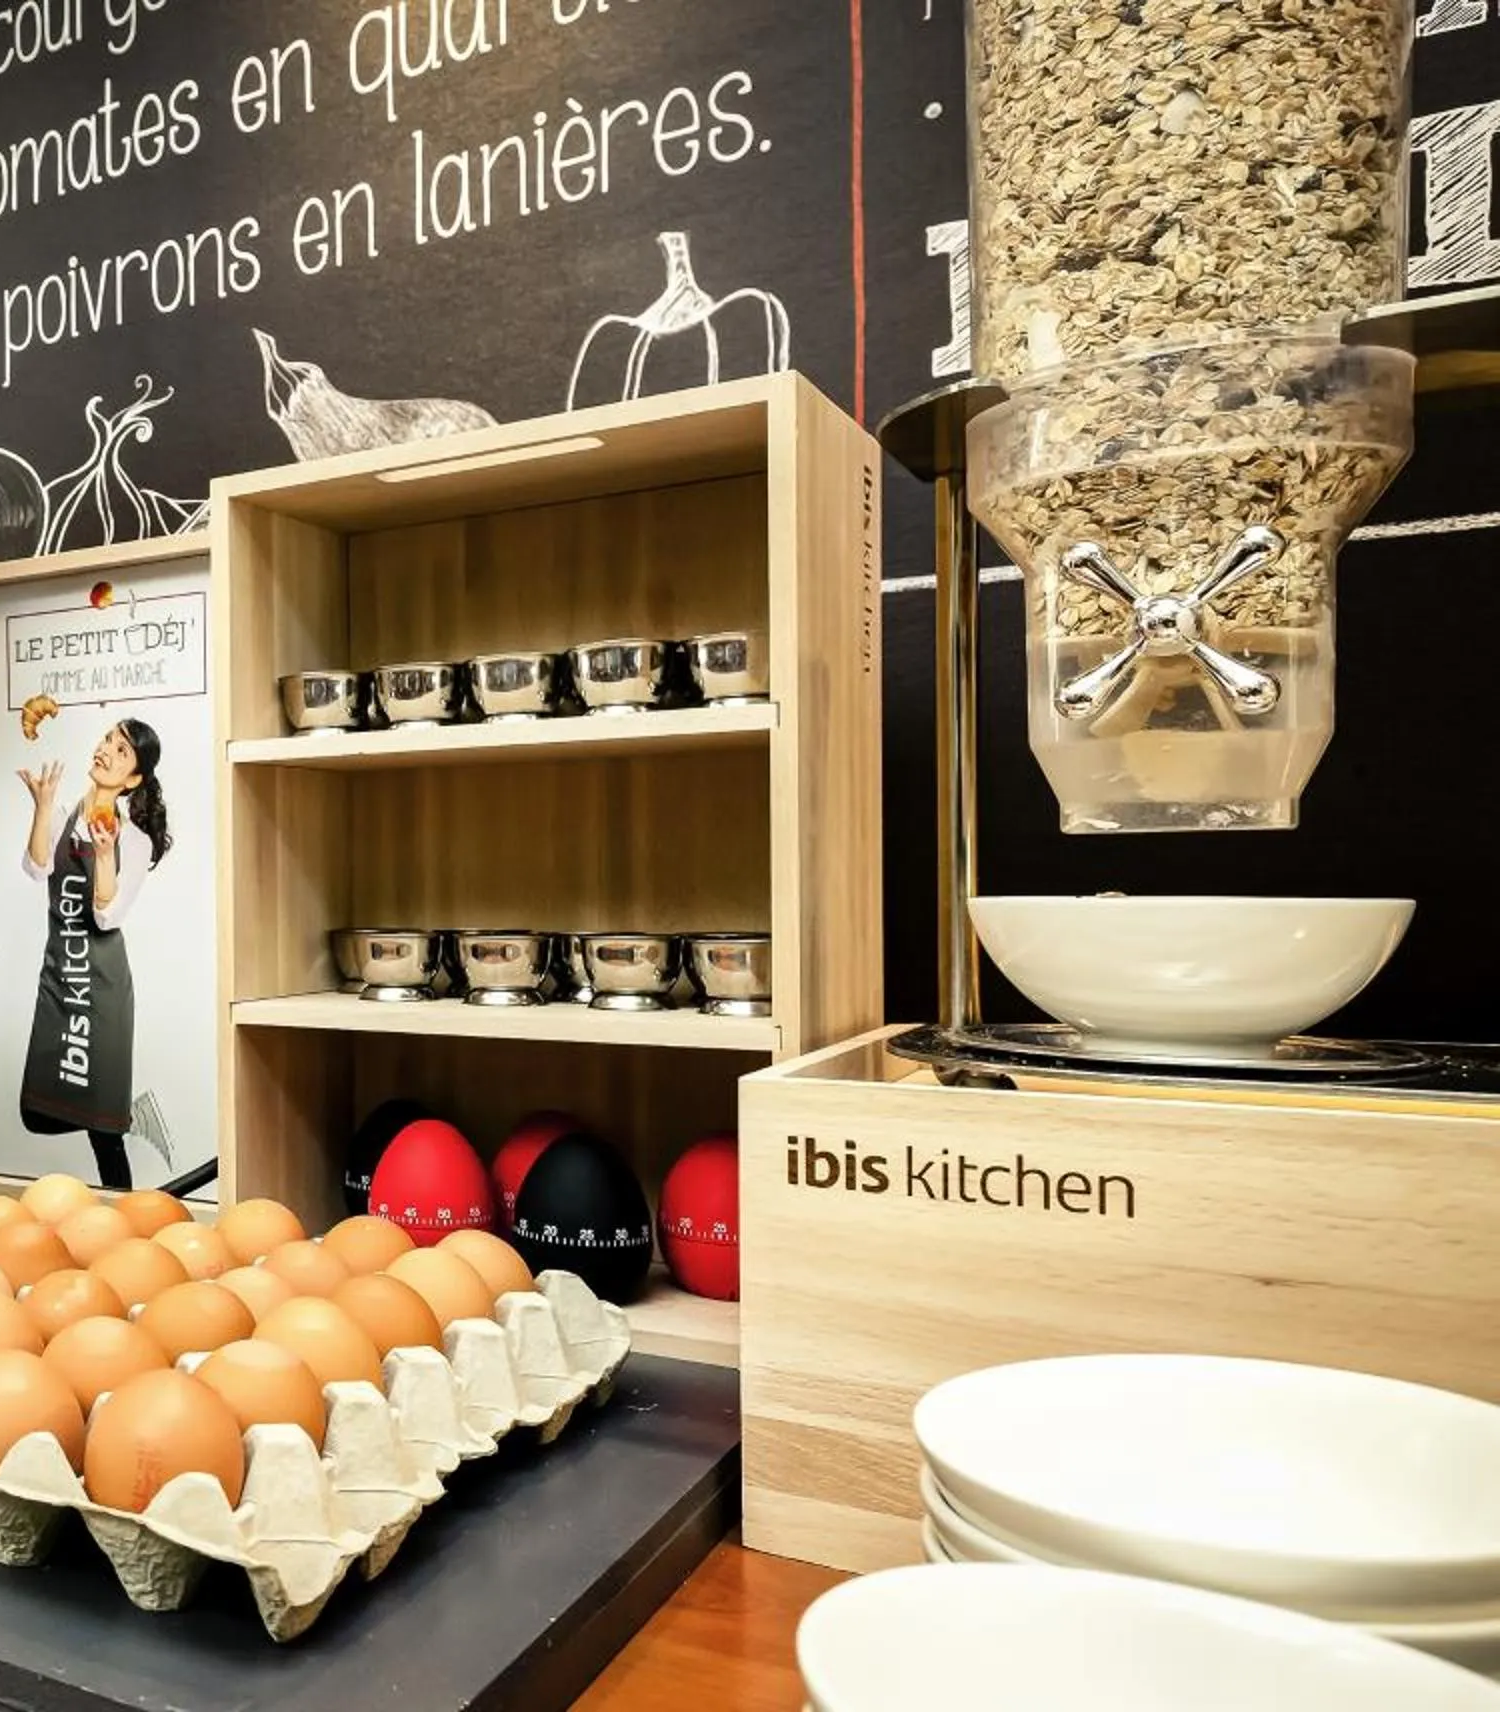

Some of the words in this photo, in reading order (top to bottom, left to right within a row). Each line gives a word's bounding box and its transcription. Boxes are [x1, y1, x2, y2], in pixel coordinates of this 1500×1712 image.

[232, 39, 315, 133] en
[2, 216, 261, 387] poivrons
[293, 182, 378, 275] en
[412, 70, 772, 245] lanières.
[15, 638, 44, 663] LE
[50, 629, 119, 659] PETIT
[59, 874, 92, 1006] kitchen
[59, 1015, 91, 1087] ibis
[787, 1135, 889, 1194] ibis
[906, 1145, 1135, 1218] kitchen
[543, 1224, 558, 1237] 20
[579, 1229, 595, 1241] 25
